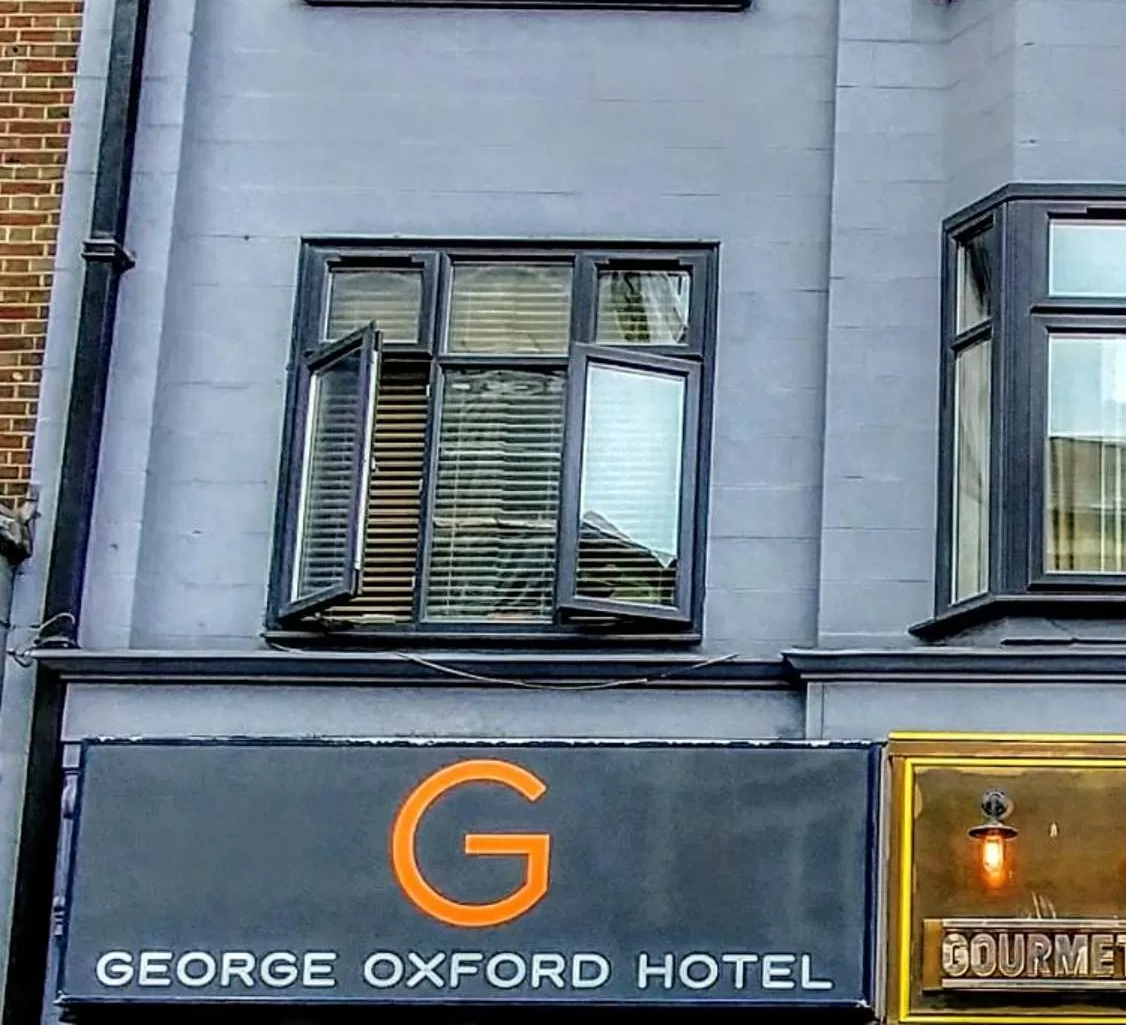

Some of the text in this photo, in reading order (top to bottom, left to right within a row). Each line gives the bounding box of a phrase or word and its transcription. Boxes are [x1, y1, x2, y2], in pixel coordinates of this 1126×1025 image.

[390, 760, 550, 927] G
[95, 951, 833, 990] GEORGE OXFORD HOTEL
